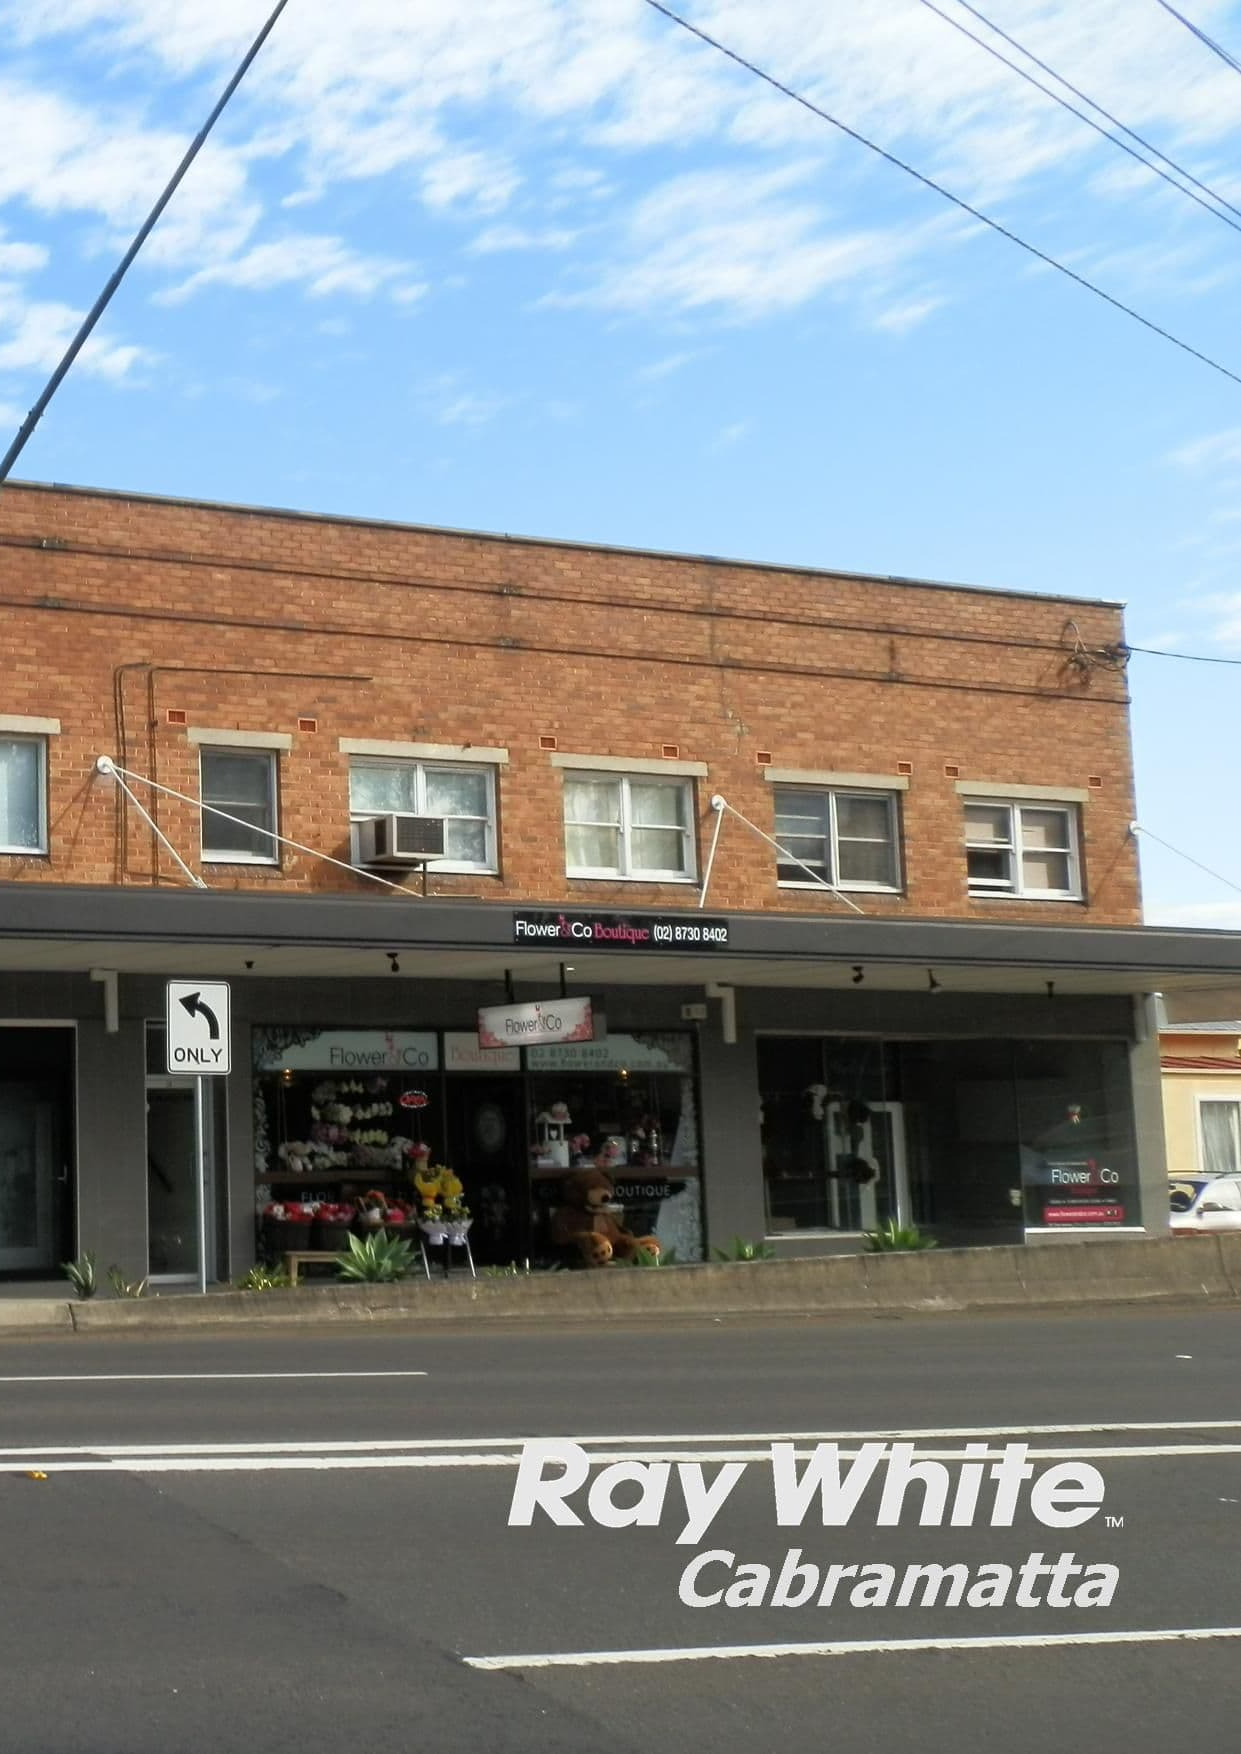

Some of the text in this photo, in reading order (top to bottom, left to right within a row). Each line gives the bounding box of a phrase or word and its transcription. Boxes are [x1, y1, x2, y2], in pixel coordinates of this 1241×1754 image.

[594, 922, 650, 945] Boutique
[653, 924, 673, 942] (02)
[675, 925, 701, 941] 8730
[702, 926, 728, 942] 8402
[174, 1047, 223, 1065] ONLY
[1051, 1169, 1091, 1184] Flower
